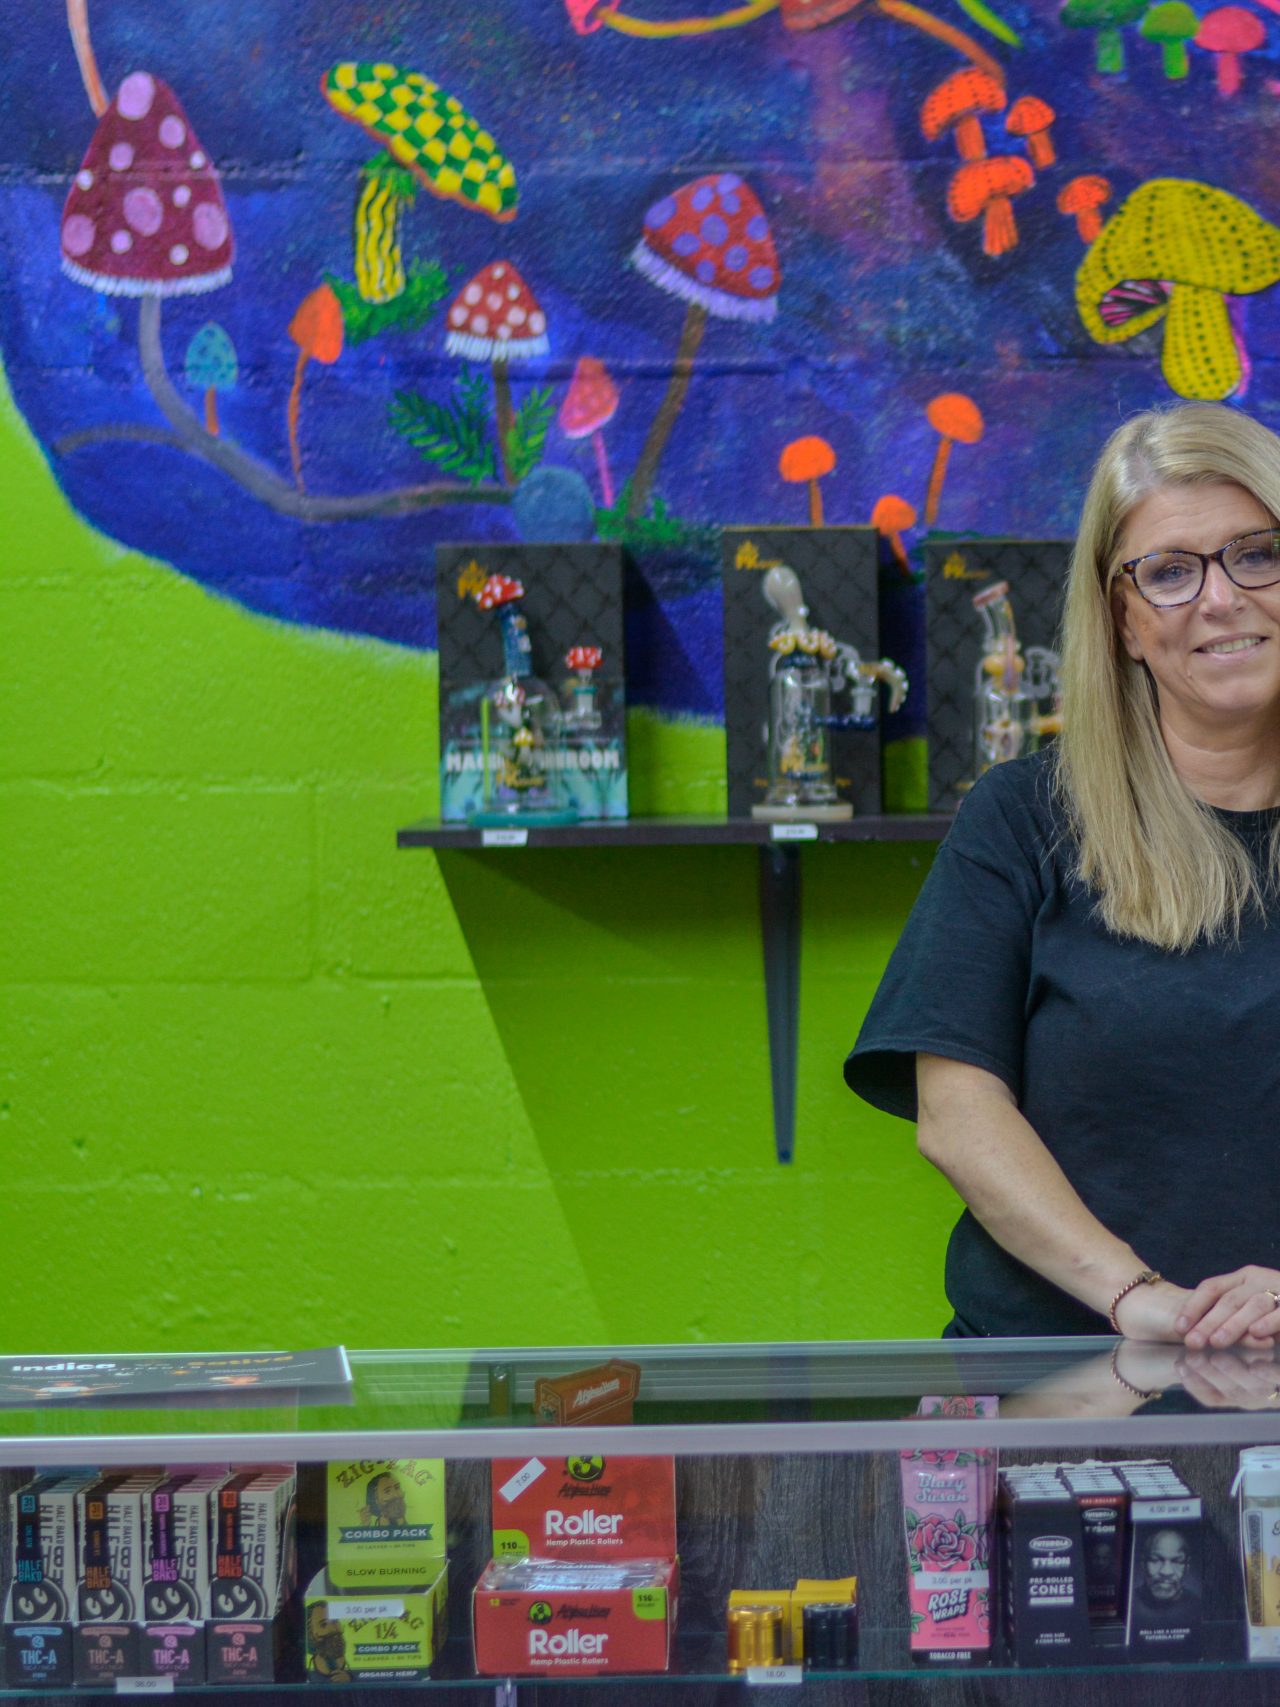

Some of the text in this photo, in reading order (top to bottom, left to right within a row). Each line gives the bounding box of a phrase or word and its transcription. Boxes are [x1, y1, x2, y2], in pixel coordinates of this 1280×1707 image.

[187, 1354, 294, 1367] Sativa
[11, 1362, 117, 1372] Indica
[515, 1472, 531, 1487] 7.00
[56, 1504, 65, 1524] HALF
[123, 1504, 133, 1524] HALF
[191, 1504, 199, 1524] HALF
[258, 1502, 267, 1522] HALF
[545, 1509, 624, 1535] Roller
[344, 1527, 428, 1539] COMBO PACK
[501, 1541, 518, 1550] 110
[546, 1537, 624, 1547] Hemp Plastic Rollers
[18, 1559, 42, 1570] HALF
[152, 1558, 177, 1569] HALF
[218, 1555, 242, 1566] HALF
[1032, 1556, 1071, 1567] TYSON
[86, 1566, 110, 1577] HALF
[346, 1566, 427, 1577] SLOW BURNING
[1029, 1576, 1074, 1584] PRE-ROLLED
[1029, 1584, 1074, 1595] CONES
[928, 1589, 968, 1611] ROSE
[932, 1603, 967, 1622] WRAPS
[529, 1628, 609, 1655] Roller
[358, 1644, 417, 1653] COMBO PACK
[21, 1649, 57, 1665] THC-A
[89, 1649, 124, 1665] THC-A
[153, 1649, 189, 1665] THC-A
[222, 1647, 258, 1663] THC-A
[531, 1656, 609, 1666] Hemp Plastic Rollers
[929, 1651, 971, 1660] TOBACCO FREE
